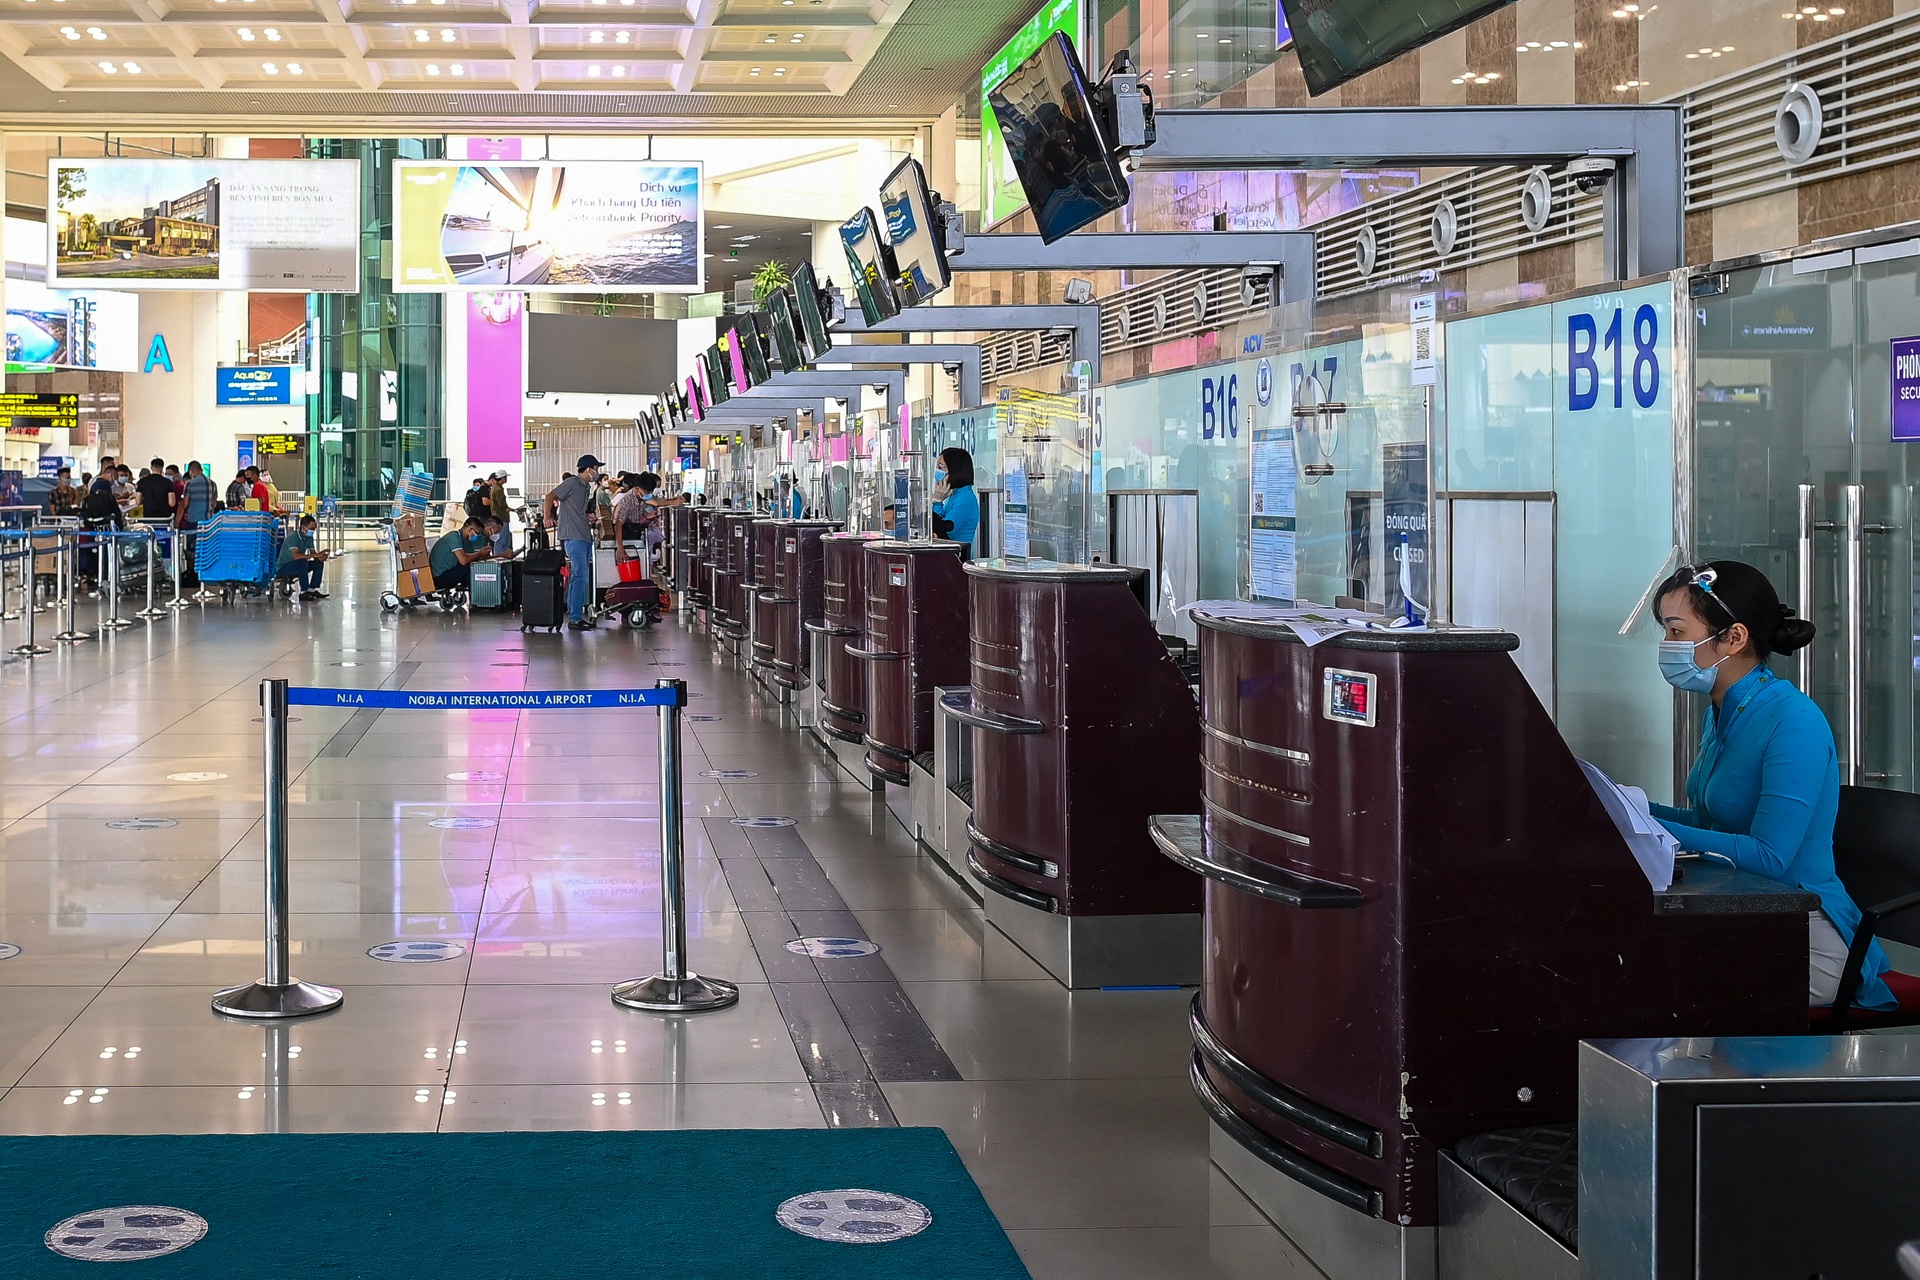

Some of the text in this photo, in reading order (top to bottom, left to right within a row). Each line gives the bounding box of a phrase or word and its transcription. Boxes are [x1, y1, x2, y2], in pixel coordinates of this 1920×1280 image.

[668, 185, 681, 194] vụ
[661, 198, 681, 207] tiên
[641, 213, 681, 223] Priority
[1243, 334, 1263, 354] ACV
[144, 335, 173, 373] A
[1567, 303, 1660, 411] B18
[1202, 373, 1238, 439] B16
[1386, 512, 1409, 529] ĐÓNG
[1393, 546, 1424, 563] CLSED
[337, 693, 646, 706] N.I.A NOIBAI INTERNATIONAL AIRPORT N.I.A
